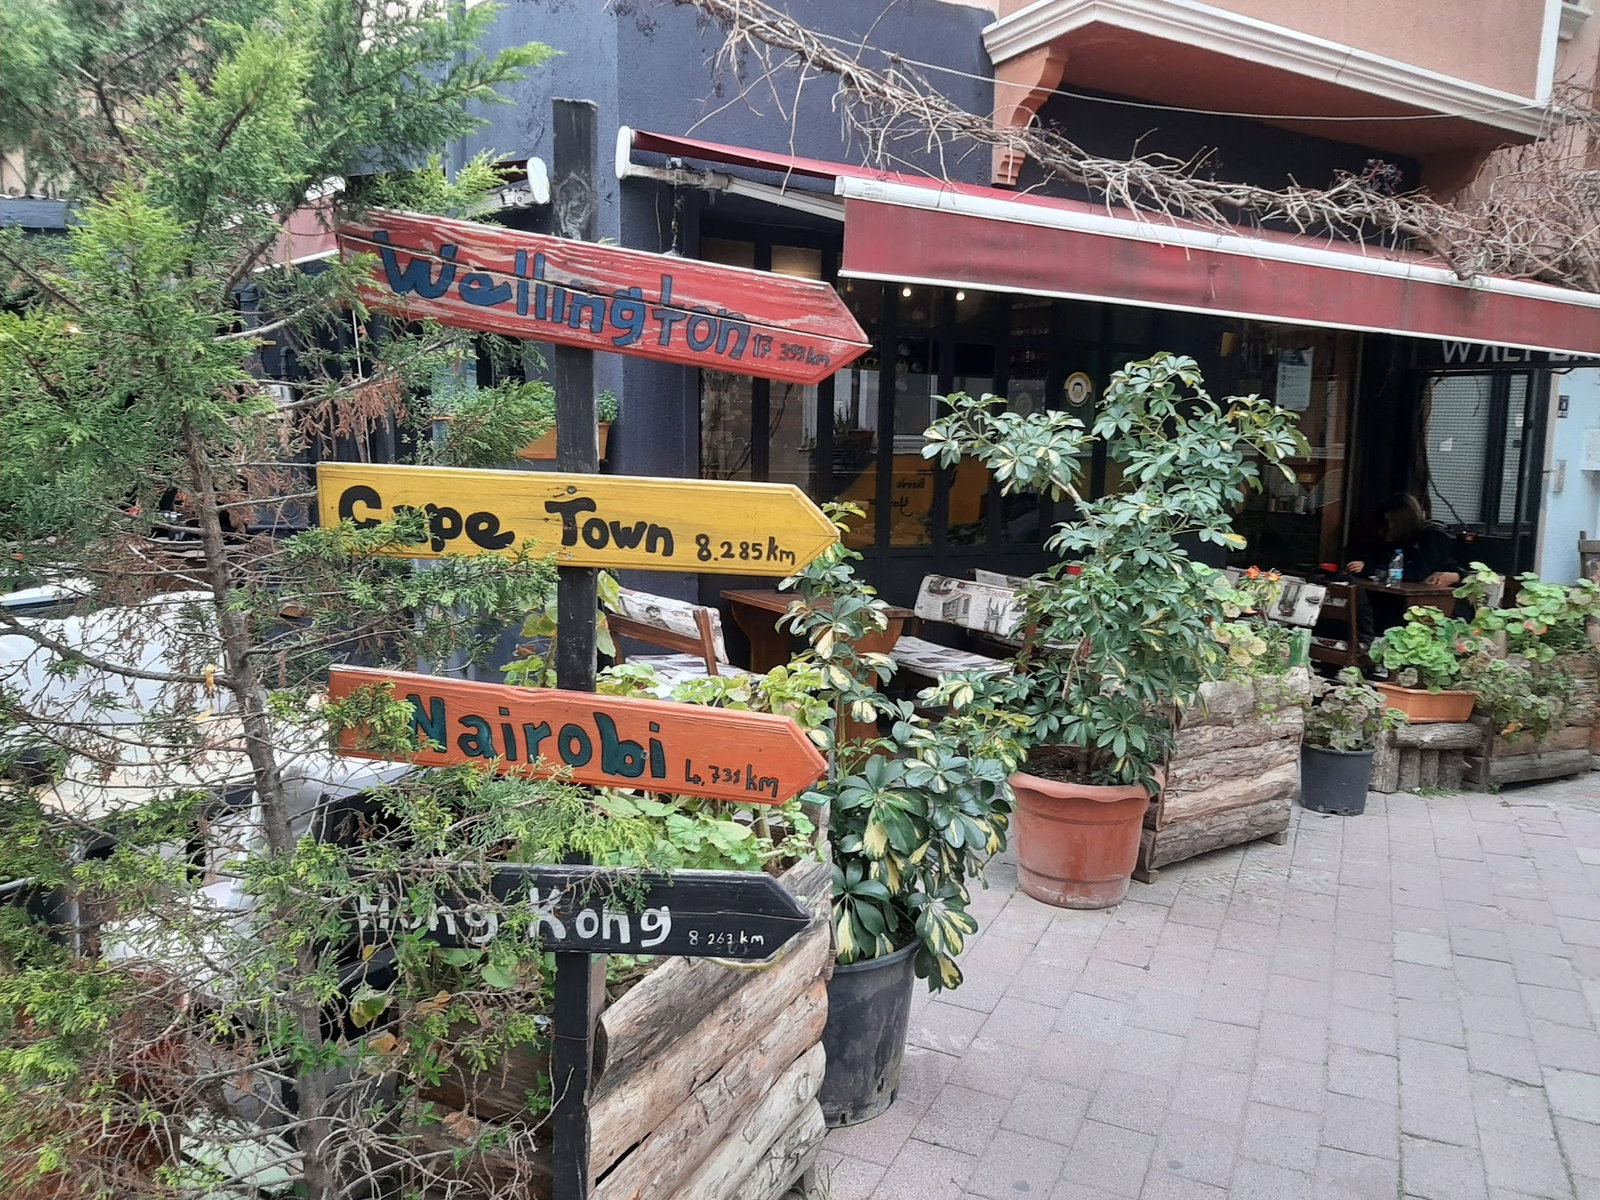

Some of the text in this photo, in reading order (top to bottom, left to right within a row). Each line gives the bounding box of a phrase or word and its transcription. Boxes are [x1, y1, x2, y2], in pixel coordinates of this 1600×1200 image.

[373, 230, 751, 360] Wellington
[544, 496, 675, 557] Town
[405, 693, 667, 780] Nairobi
[528, 887, 674, 948] Kong
